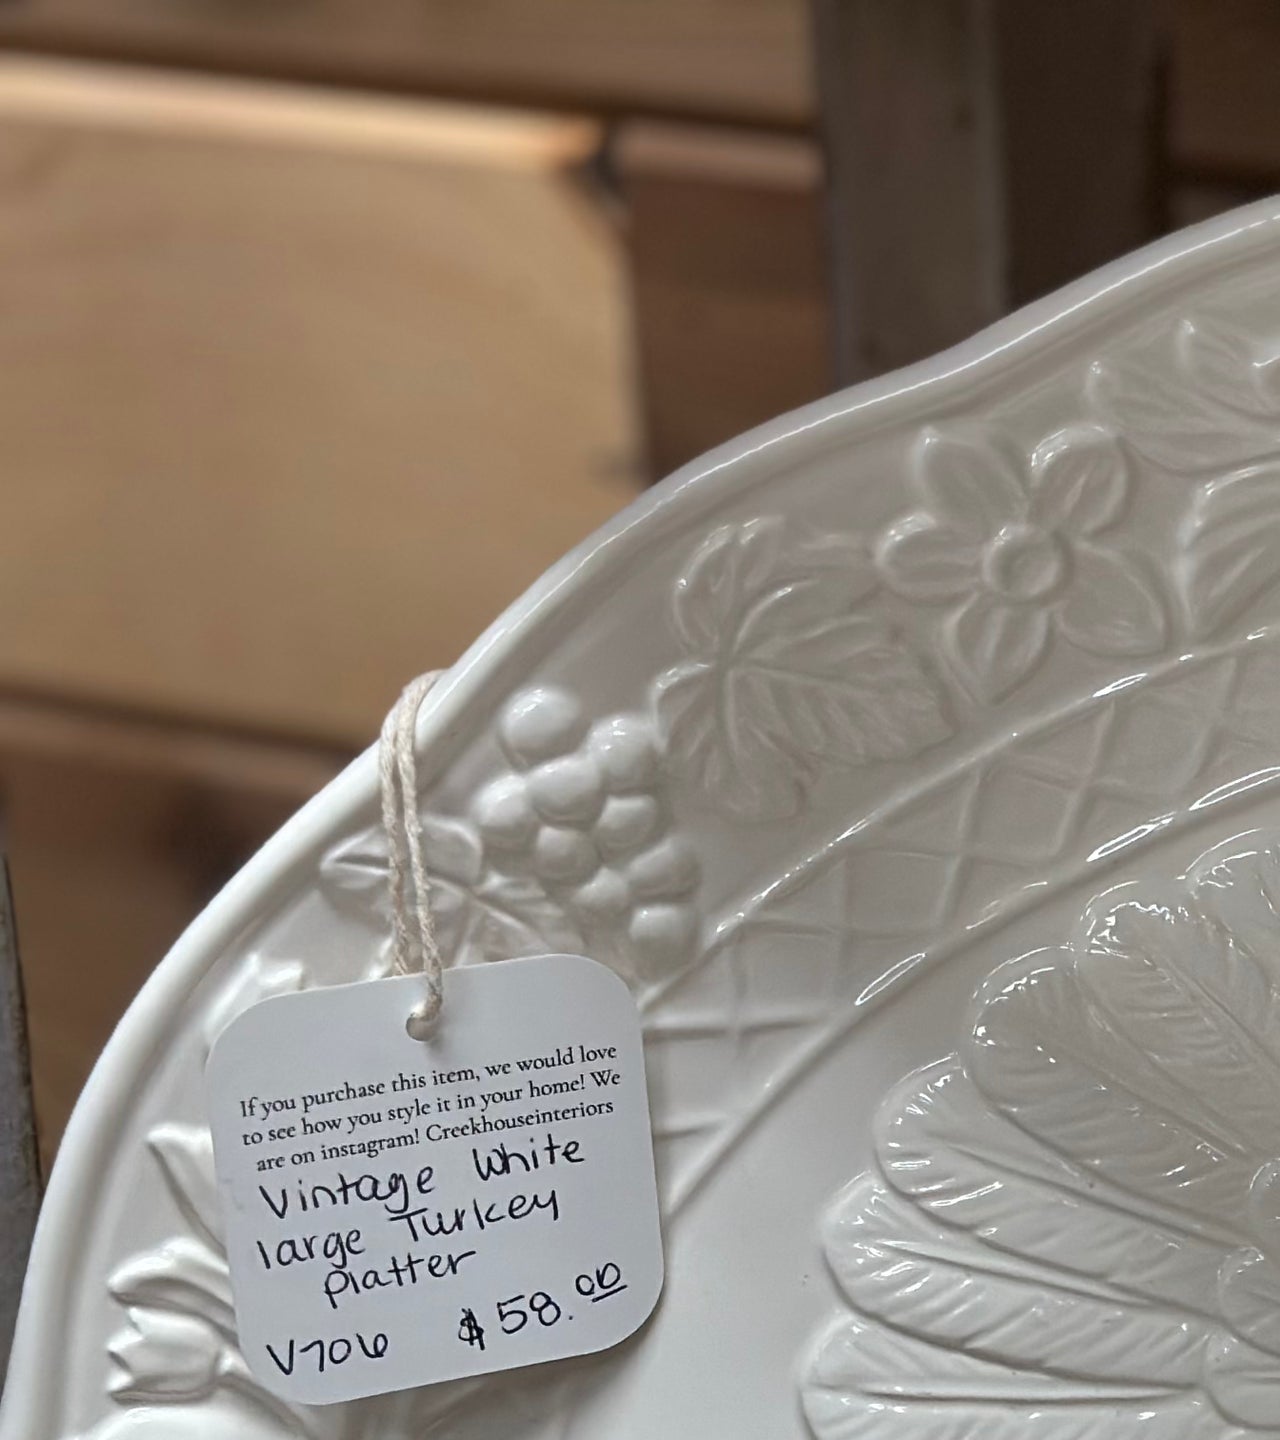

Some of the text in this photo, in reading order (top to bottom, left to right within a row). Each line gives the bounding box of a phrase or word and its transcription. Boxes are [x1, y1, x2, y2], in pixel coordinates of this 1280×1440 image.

[240, 1045, 616, 1121] If you purchase this item, we would love
[243, 1069, 620, 1146] to see how you style it in your home! We
[257, 1100, 614, 1172] are on instagram! Creekhouseinteriors
[257, 1190, 558, 1269] large Turkey
[259, 1165, 434, 1219] Vintage
